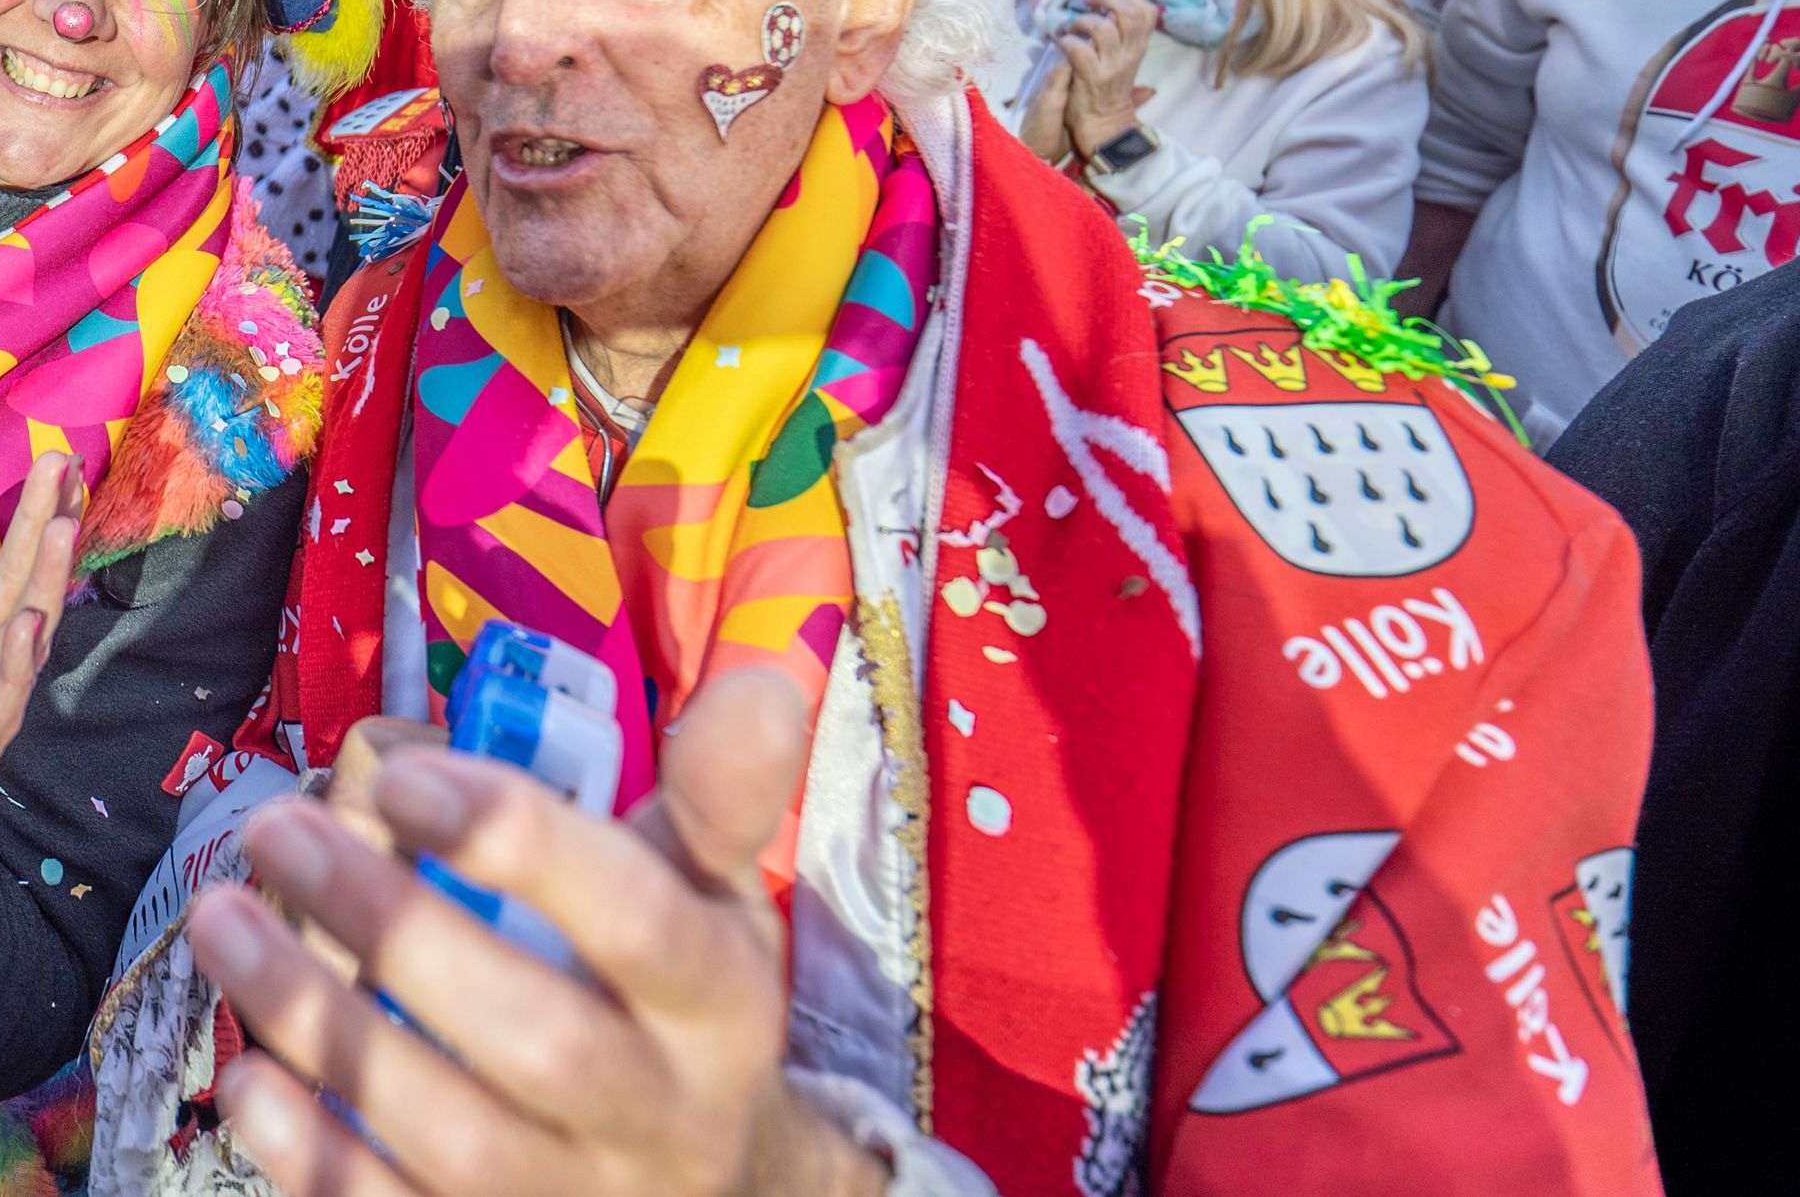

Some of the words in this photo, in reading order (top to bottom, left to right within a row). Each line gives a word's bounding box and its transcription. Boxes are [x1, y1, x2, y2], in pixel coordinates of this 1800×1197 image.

[1687, 259, 1743, 292] KÖ
[330, 294, 388, 382] Kölle
[1282, 588, 1485, 699] Kölle
[1475, 893, 1589, 1106] Kölle
